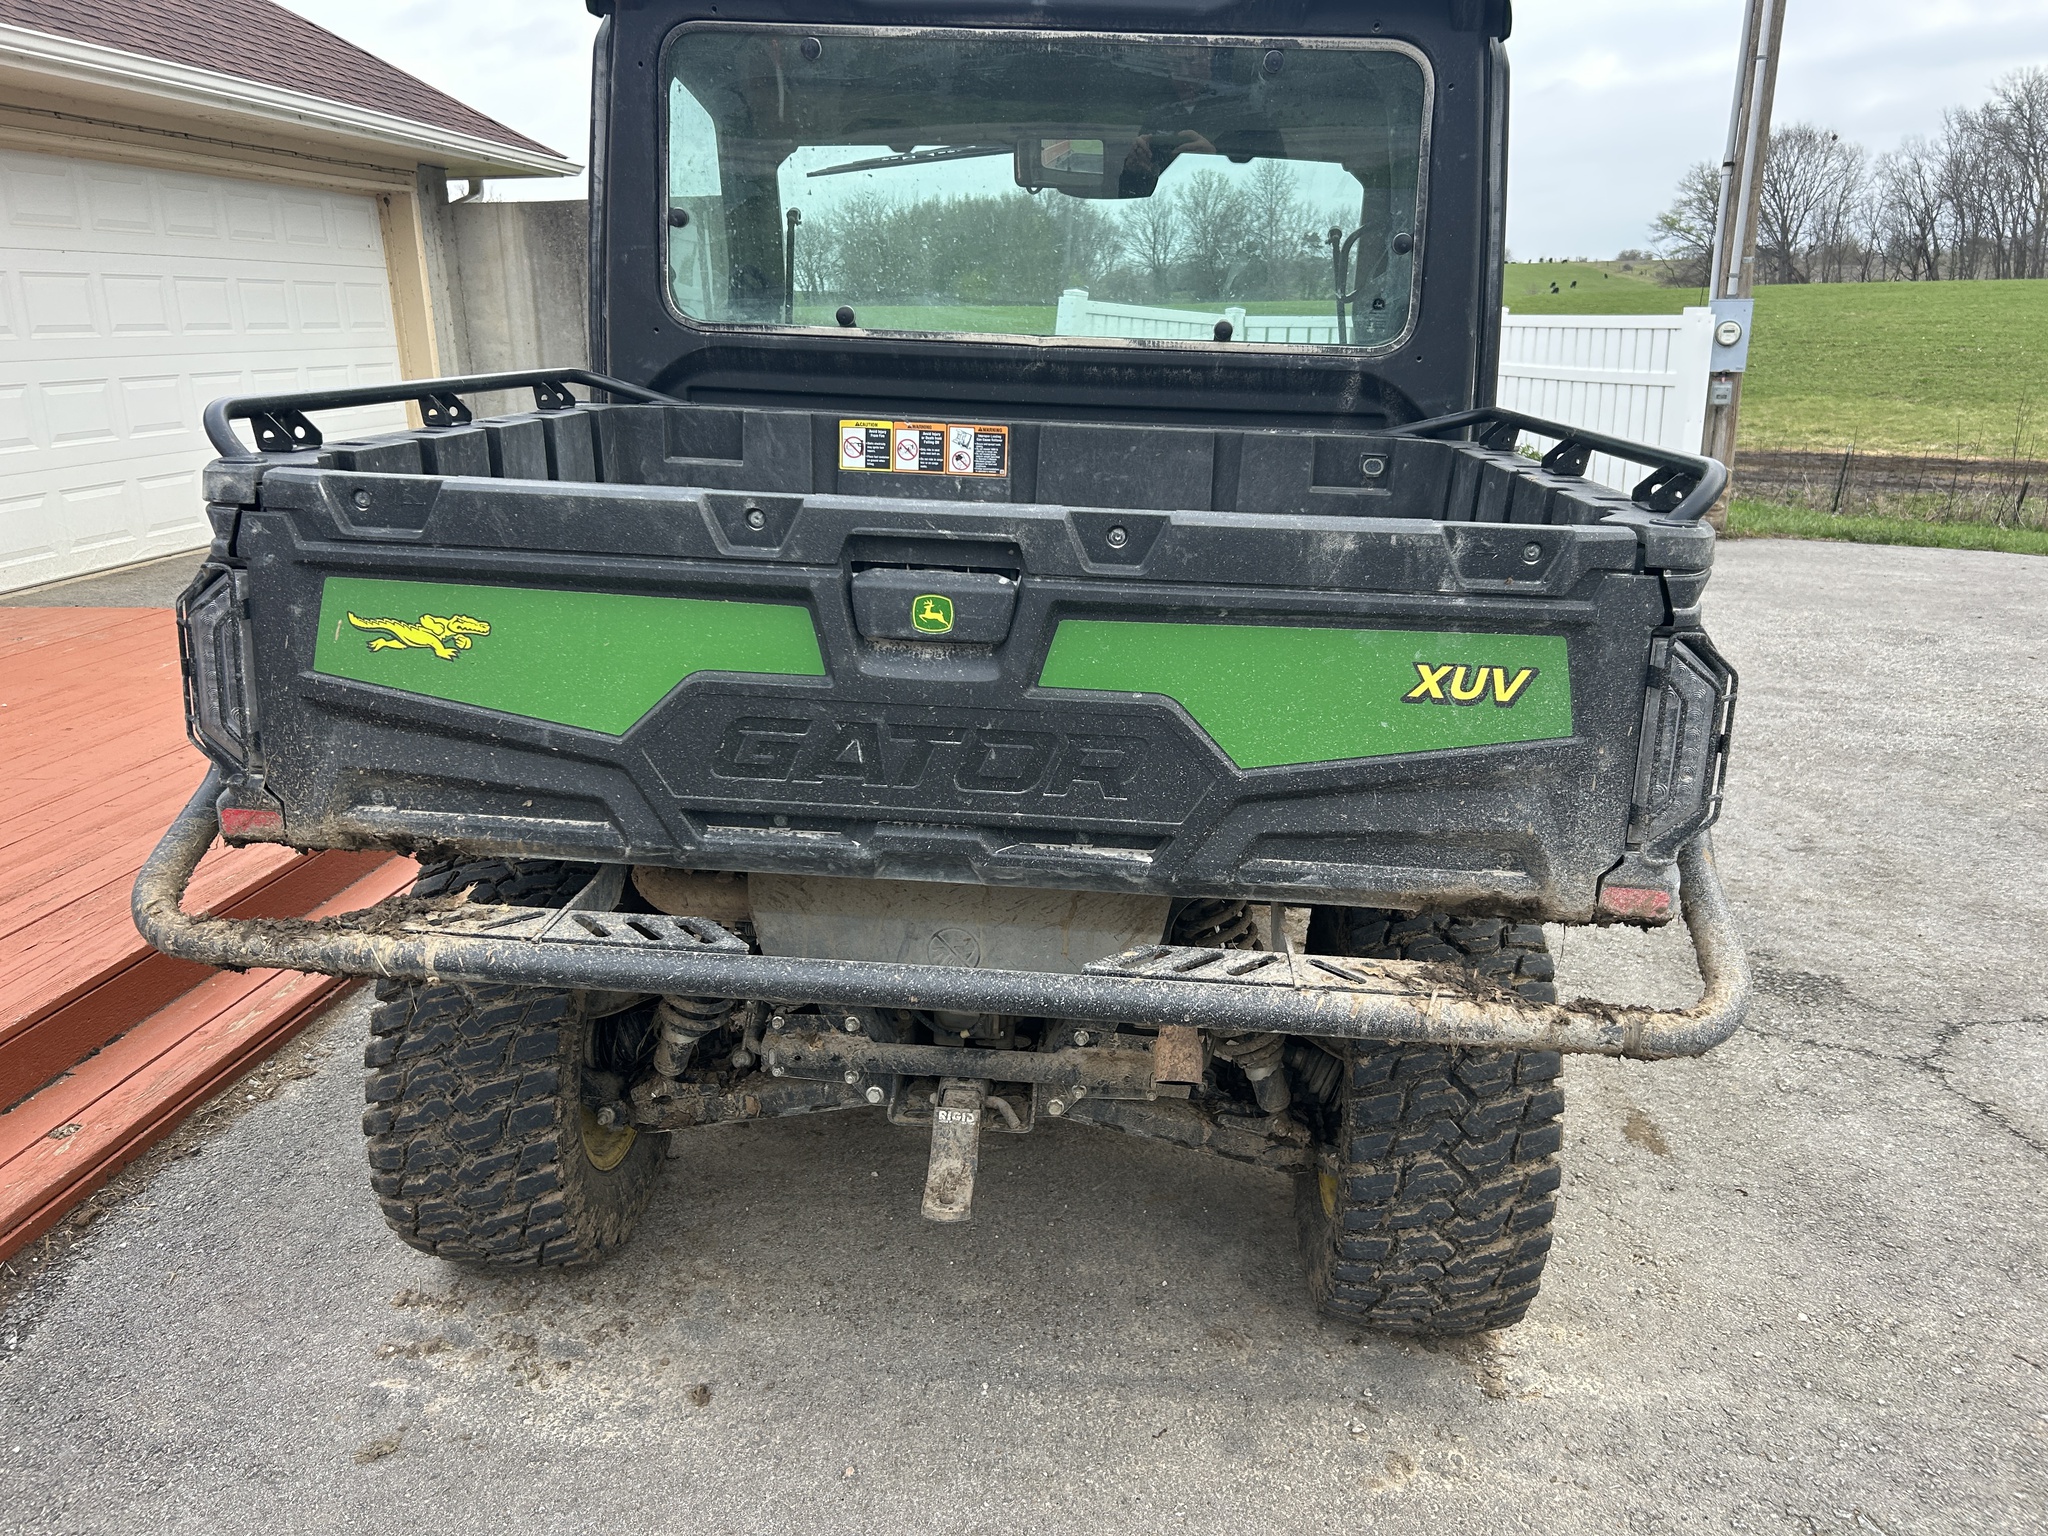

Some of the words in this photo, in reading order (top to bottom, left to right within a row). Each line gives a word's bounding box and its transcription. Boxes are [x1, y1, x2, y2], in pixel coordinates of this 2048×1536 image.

[1400, 661, 1541, 709] XUV
[710, 716, 1151, 800] GATOR
[938, 1110, 976, 1125] RIGID
